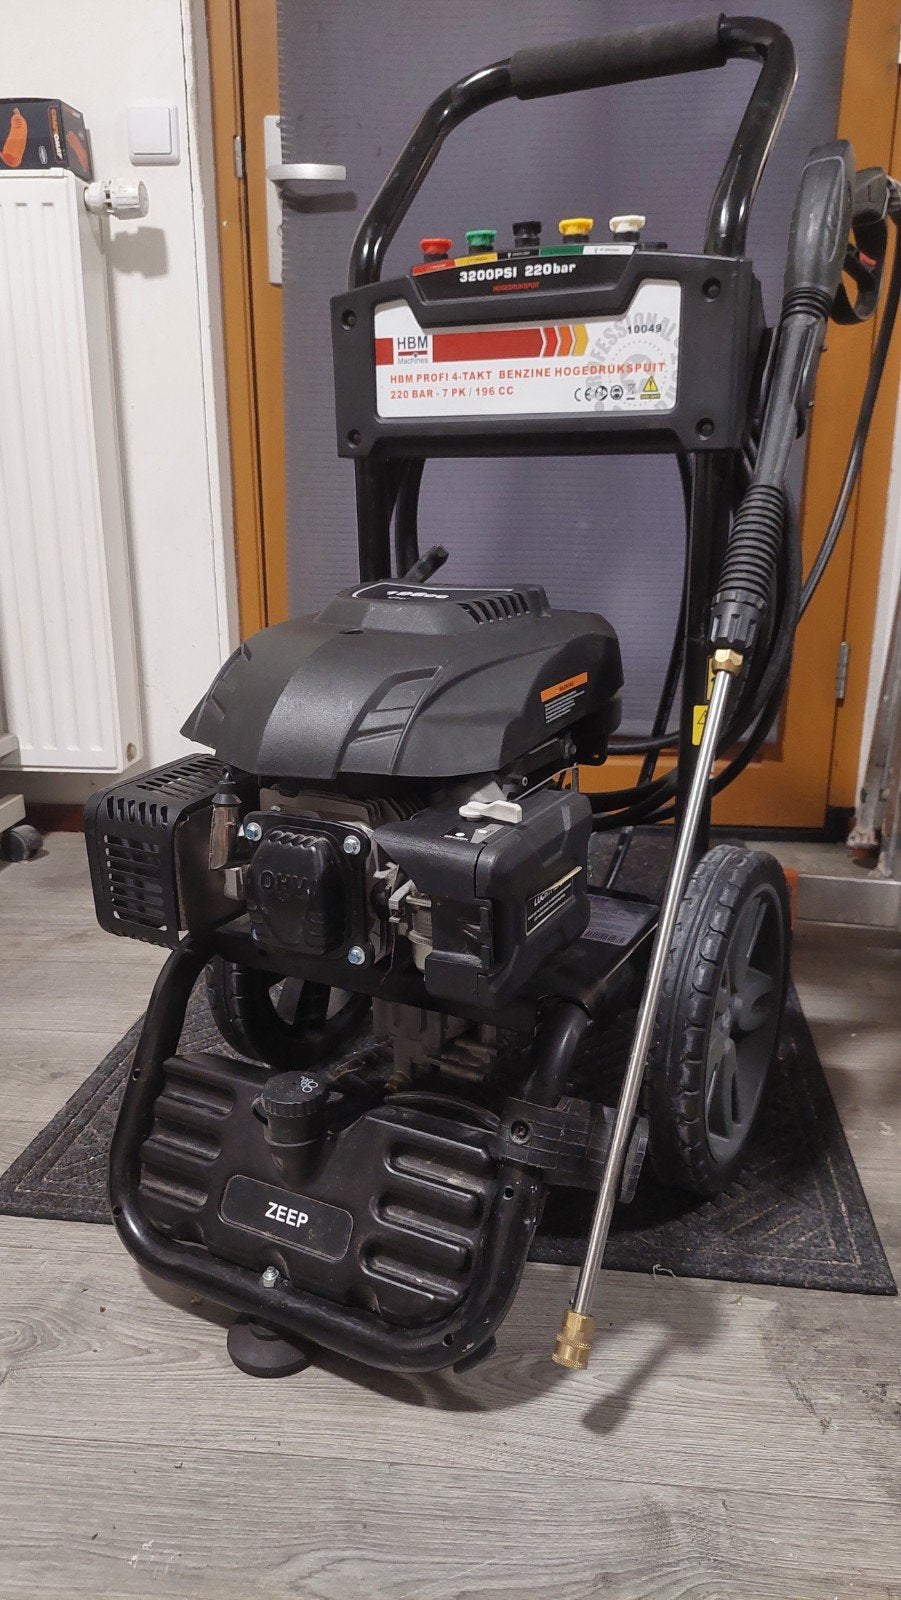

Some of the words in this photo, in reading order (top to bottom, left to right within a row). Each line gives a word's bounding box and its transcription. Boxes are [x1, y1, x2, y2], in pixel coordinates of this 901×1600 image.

[459, 266, 517, 282] 3200PSI
[525, 263, 577, 278] 220bar
[627, 324, 662, 335] 10049
[397, 335, 429, 350] HBM
[397, 357, 429, 365] Machines
[390, 374, 414, 384] HBM
[416, 372, 449, 383] PROFI
[452, 370, 493, 381] 4-TAKT
[498, 367, 551, 379] BENZINE
[554, 362, 666, 377] HOGEDRUKSPUIT
[390, 390, 409, 400] 220
[411, 389, 434, 399] BAR
[442, 388, 450, 397] 7
[451, 388, 467, 397] PK
[475, 386, 496, 397] 196
[498, 386, 514, 395] CC
[264, 1201, 309, 1228] ZEEP
